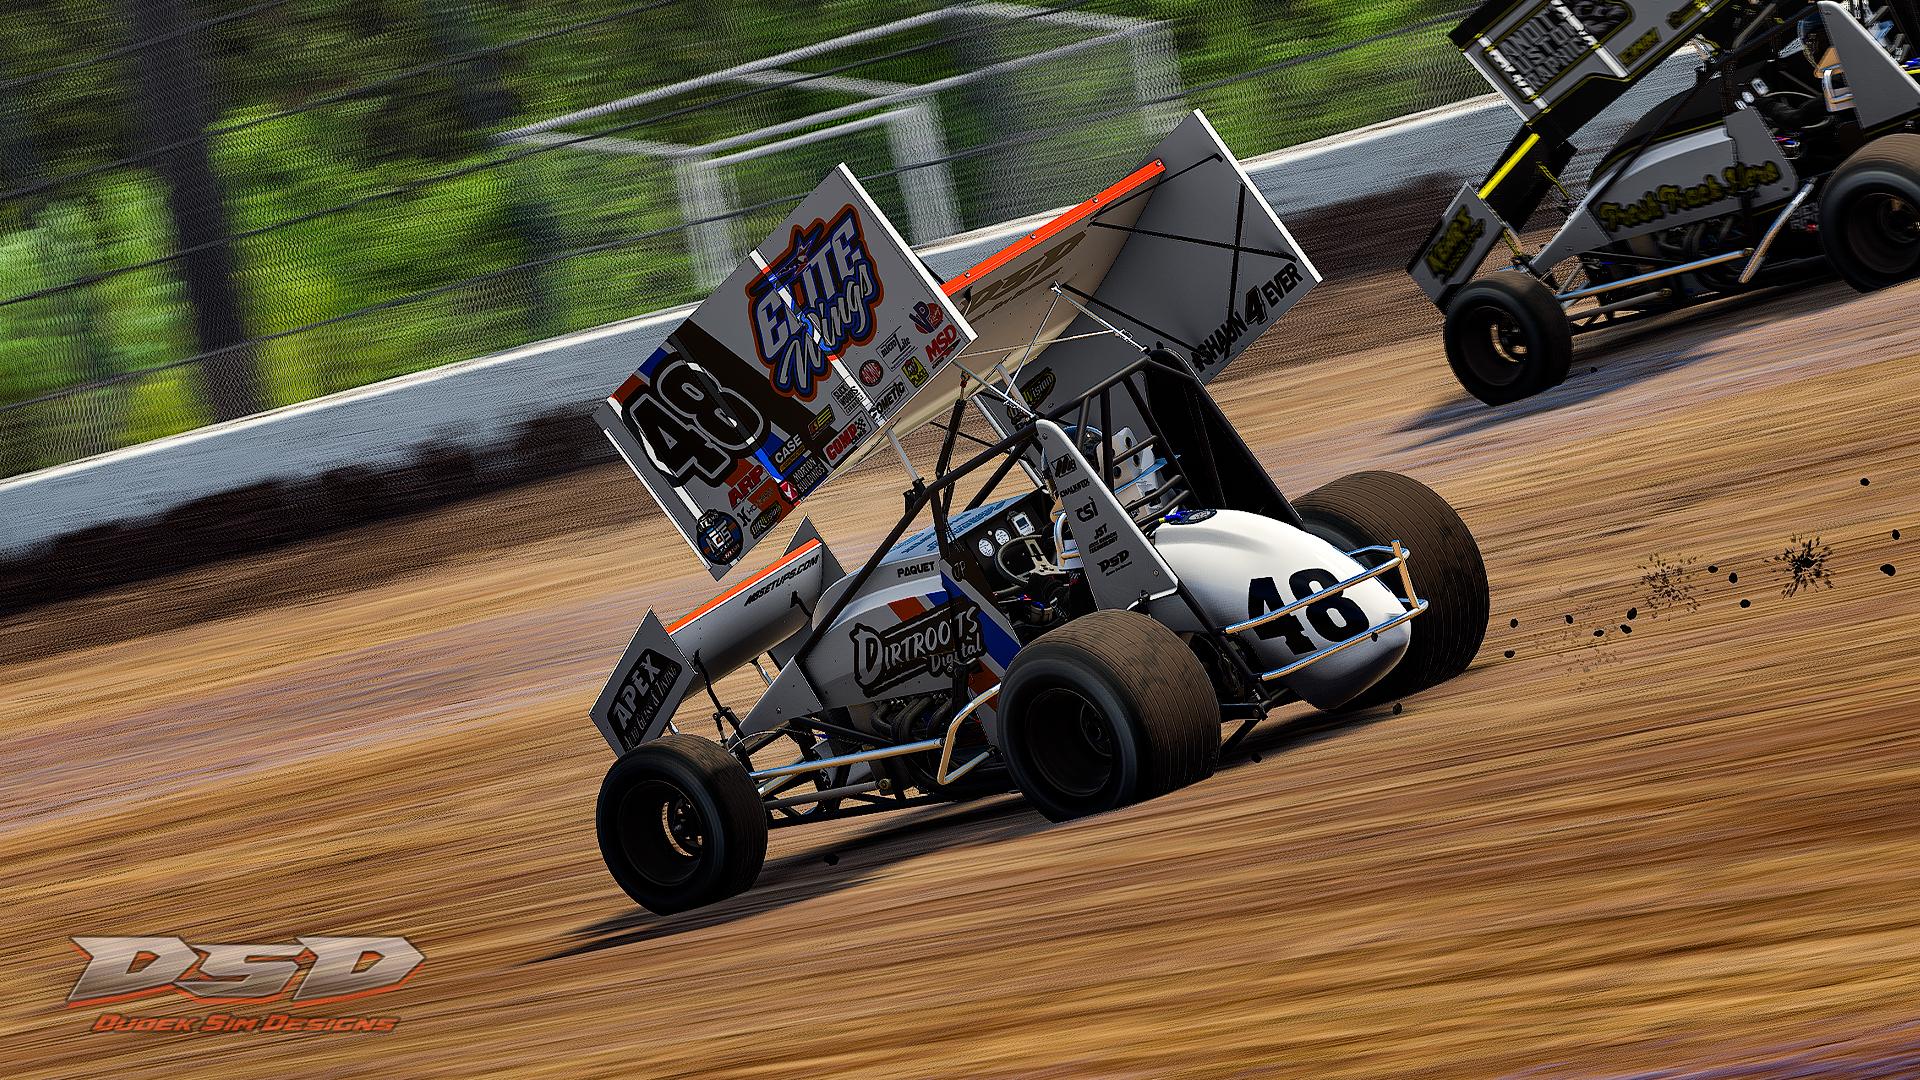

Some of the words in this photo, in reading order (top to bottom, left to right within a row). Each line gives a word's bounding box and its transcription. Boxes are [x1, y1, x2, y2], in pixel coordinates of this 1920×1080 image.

[756, 216, 864, 358] ELITE
[1262, 263, 1303, 309] EVER
[779, 263, 873, 389] Wings
[925, 324, 957, 363] MSD
[627, 357, 765, 482] 48
[774, 434, 802, 464] CASE
[825, 423, 858, 461] COMP
[728, 465, 764, 508] ARP
[792, 457, 819, 482] MORTON
[798, 463, 828, 492] BUILDINGS
[897, 560, 935, 578] PAQUET
[1248, 568, 1370, 656] 48
[613, 654, 660, 730] APEX
